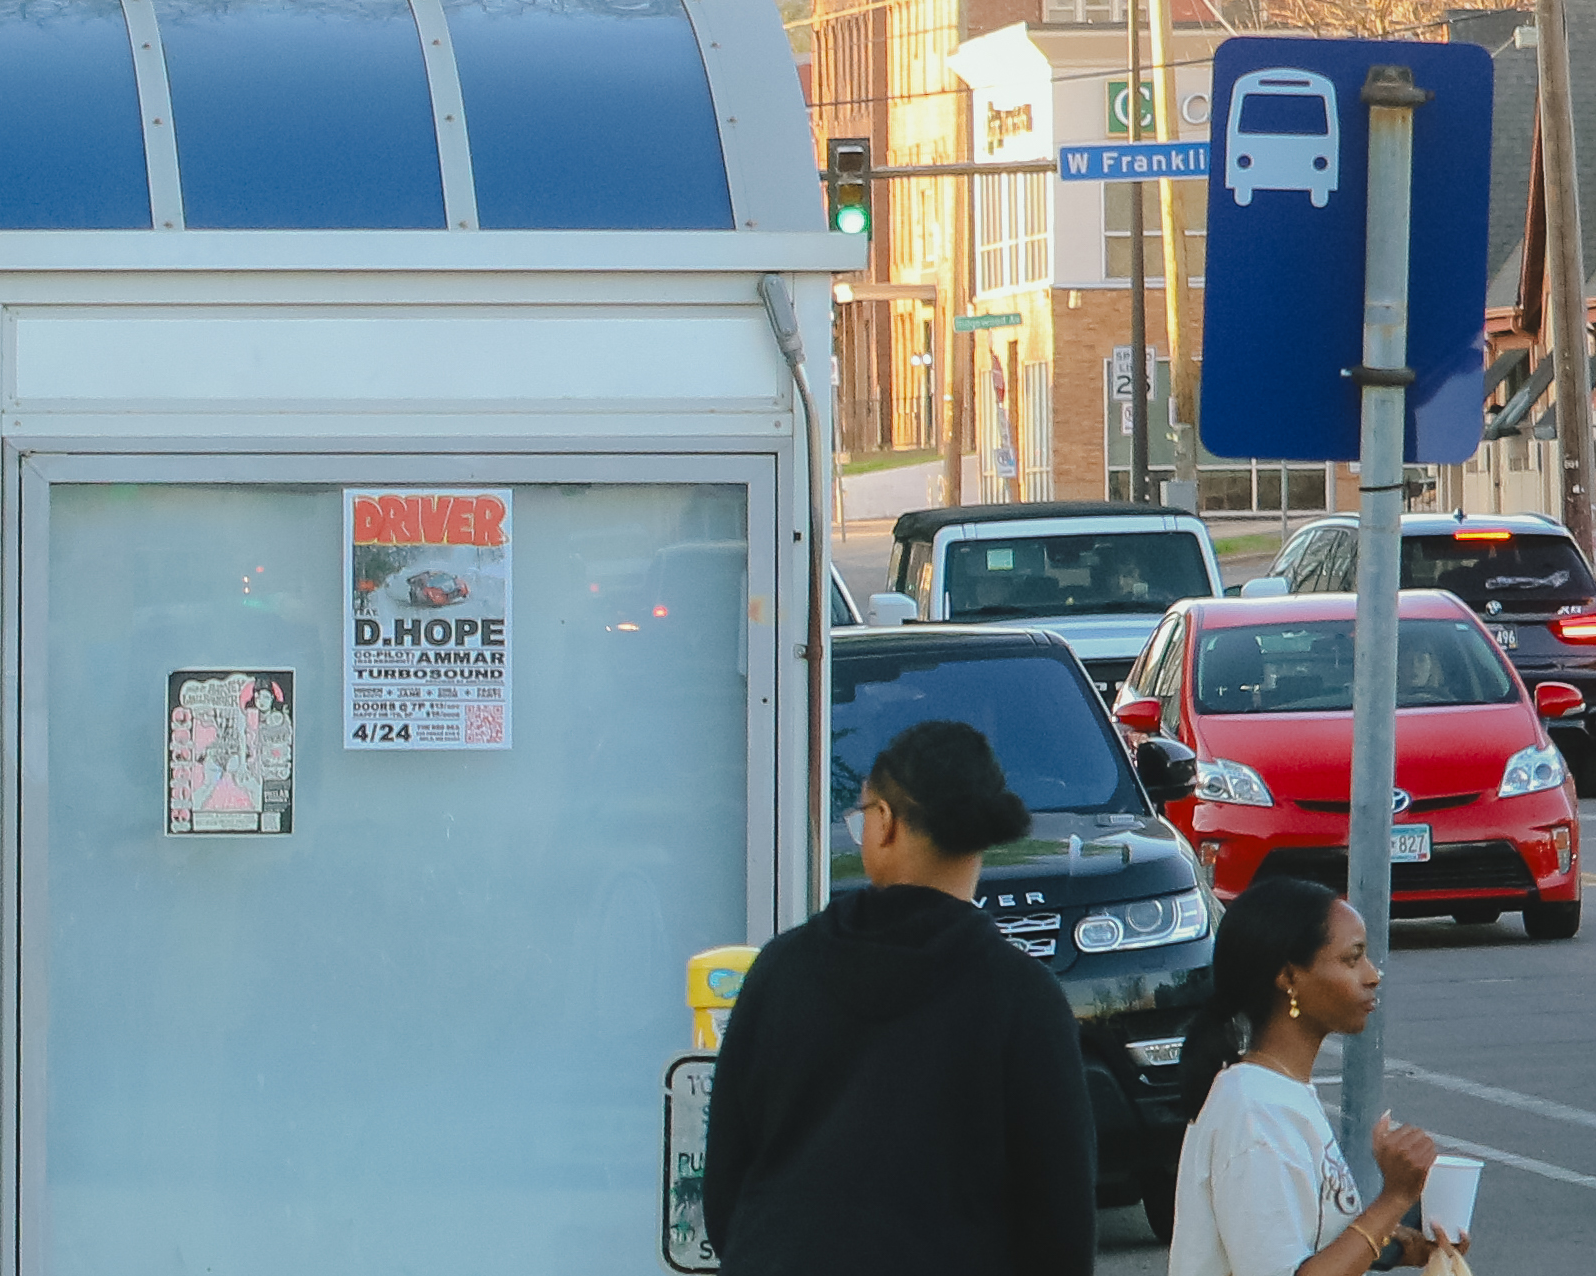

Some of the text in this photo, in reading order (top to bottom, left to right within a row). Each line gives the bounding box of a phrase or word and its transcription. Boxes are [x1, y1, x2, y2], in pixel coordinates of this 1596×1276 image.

[1066, 148, 1206, 174] W Frankli
[353, 495, 507, 546] DRIVER
[354, 618, 505, 647] D.HOPE
[416, 651, 505, 665] AMMAR
[355, 668, 504, 680] TURBOSOUND
[352, 723, 411, 743] 4/24
[971, 891, 1046, 909] VER
